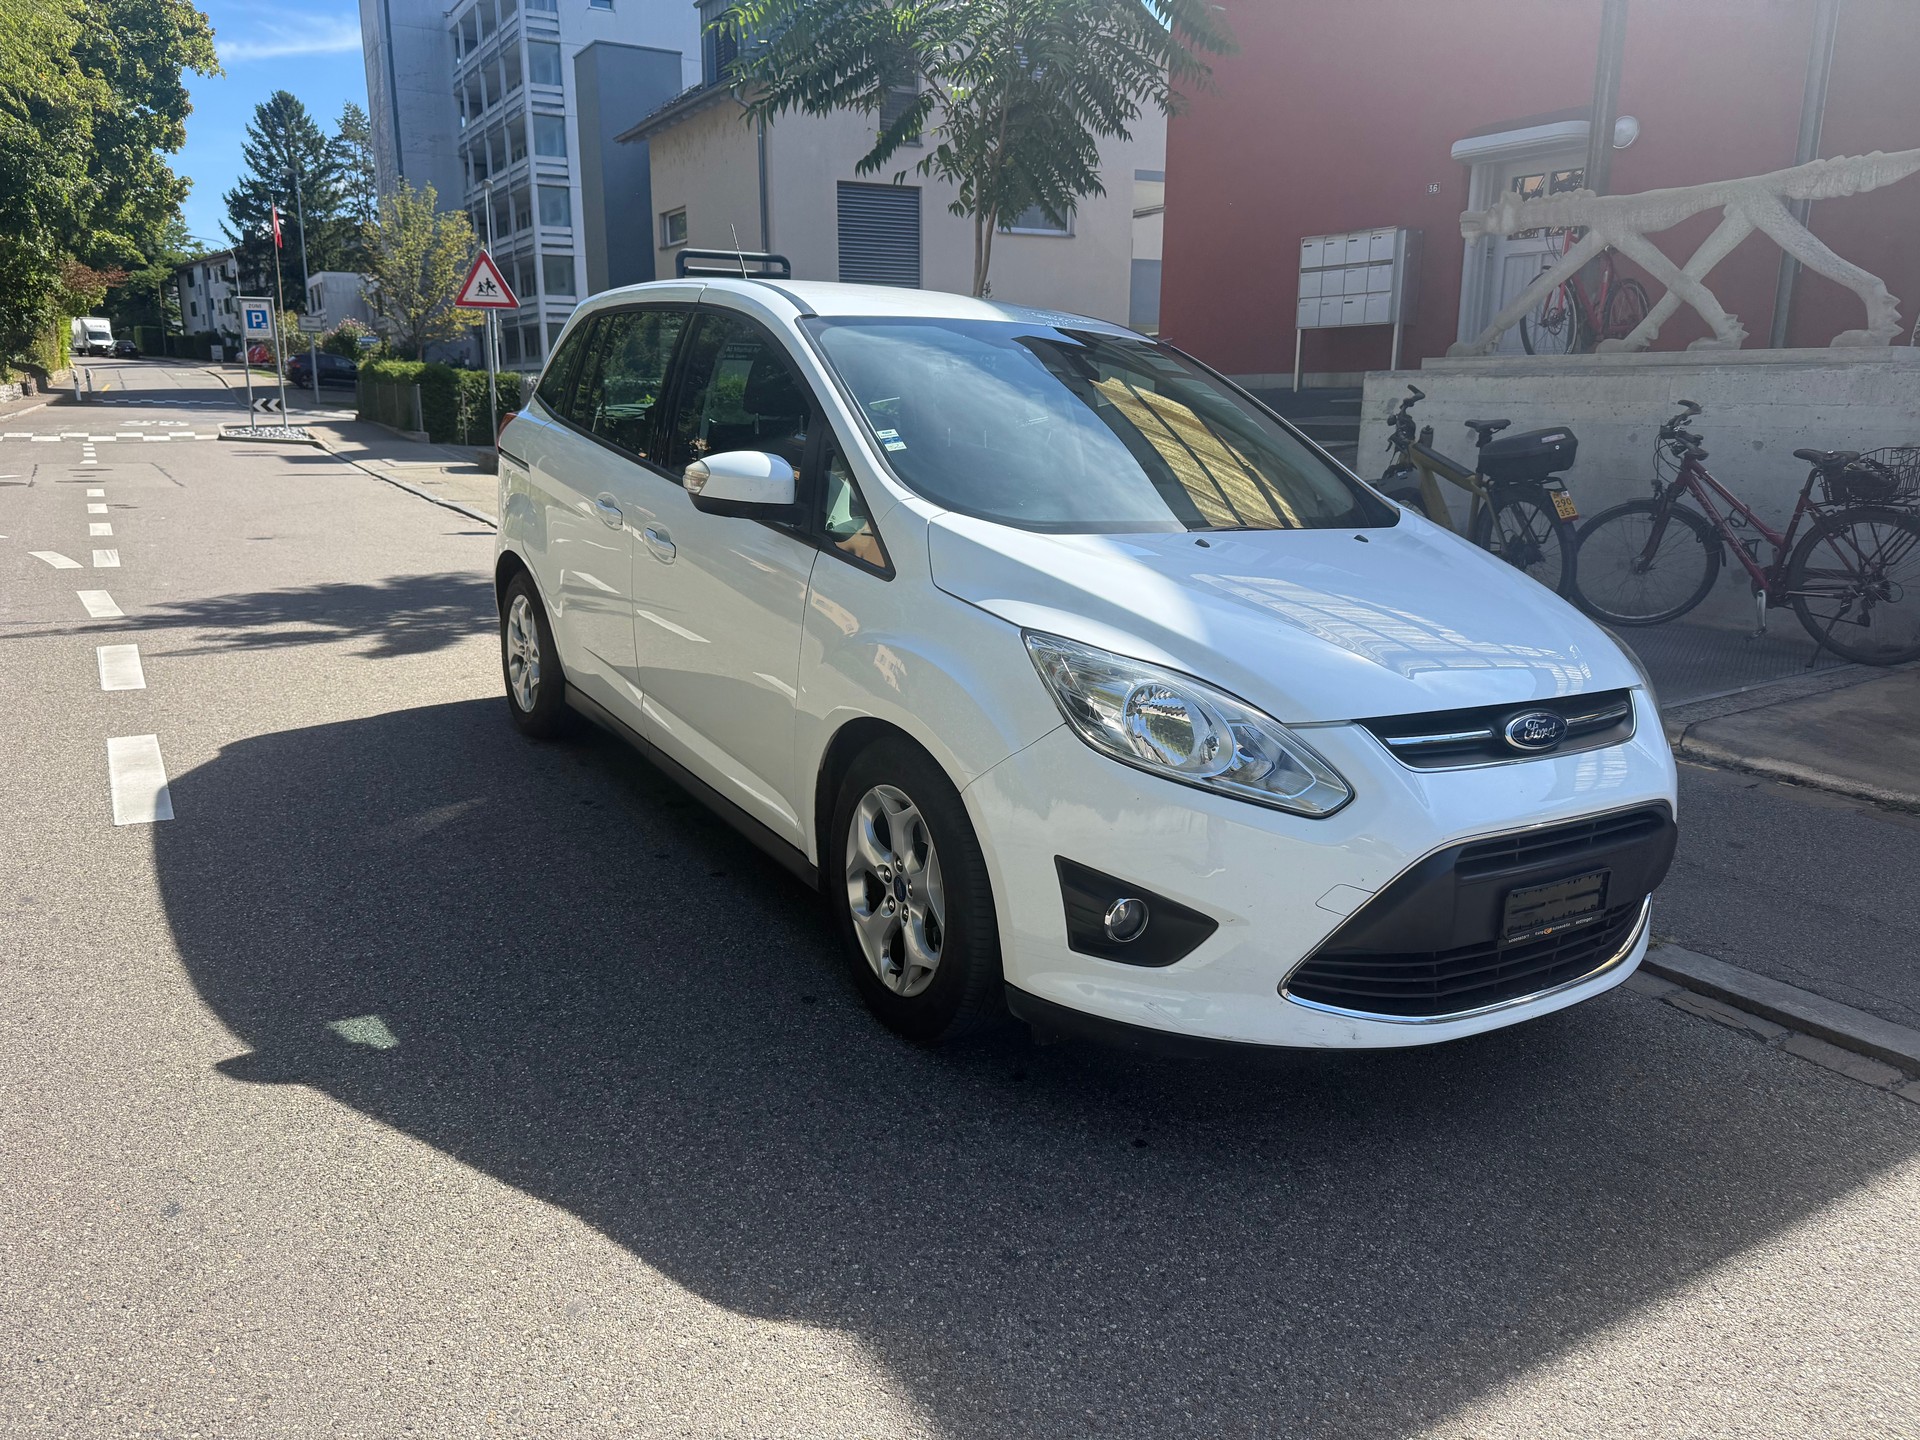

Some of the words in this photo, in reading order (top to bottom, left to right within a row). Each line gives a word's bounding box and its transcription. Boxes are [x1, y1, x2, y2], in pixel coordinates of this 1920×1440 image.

[1429, 184, 1438, 193] 36
[251, 311, 263, 327] P
[1555, 497, 1572, 508] 290
[1559, 506, 1576, 517] 353
[1524, 718, 1557, 740] Ford
